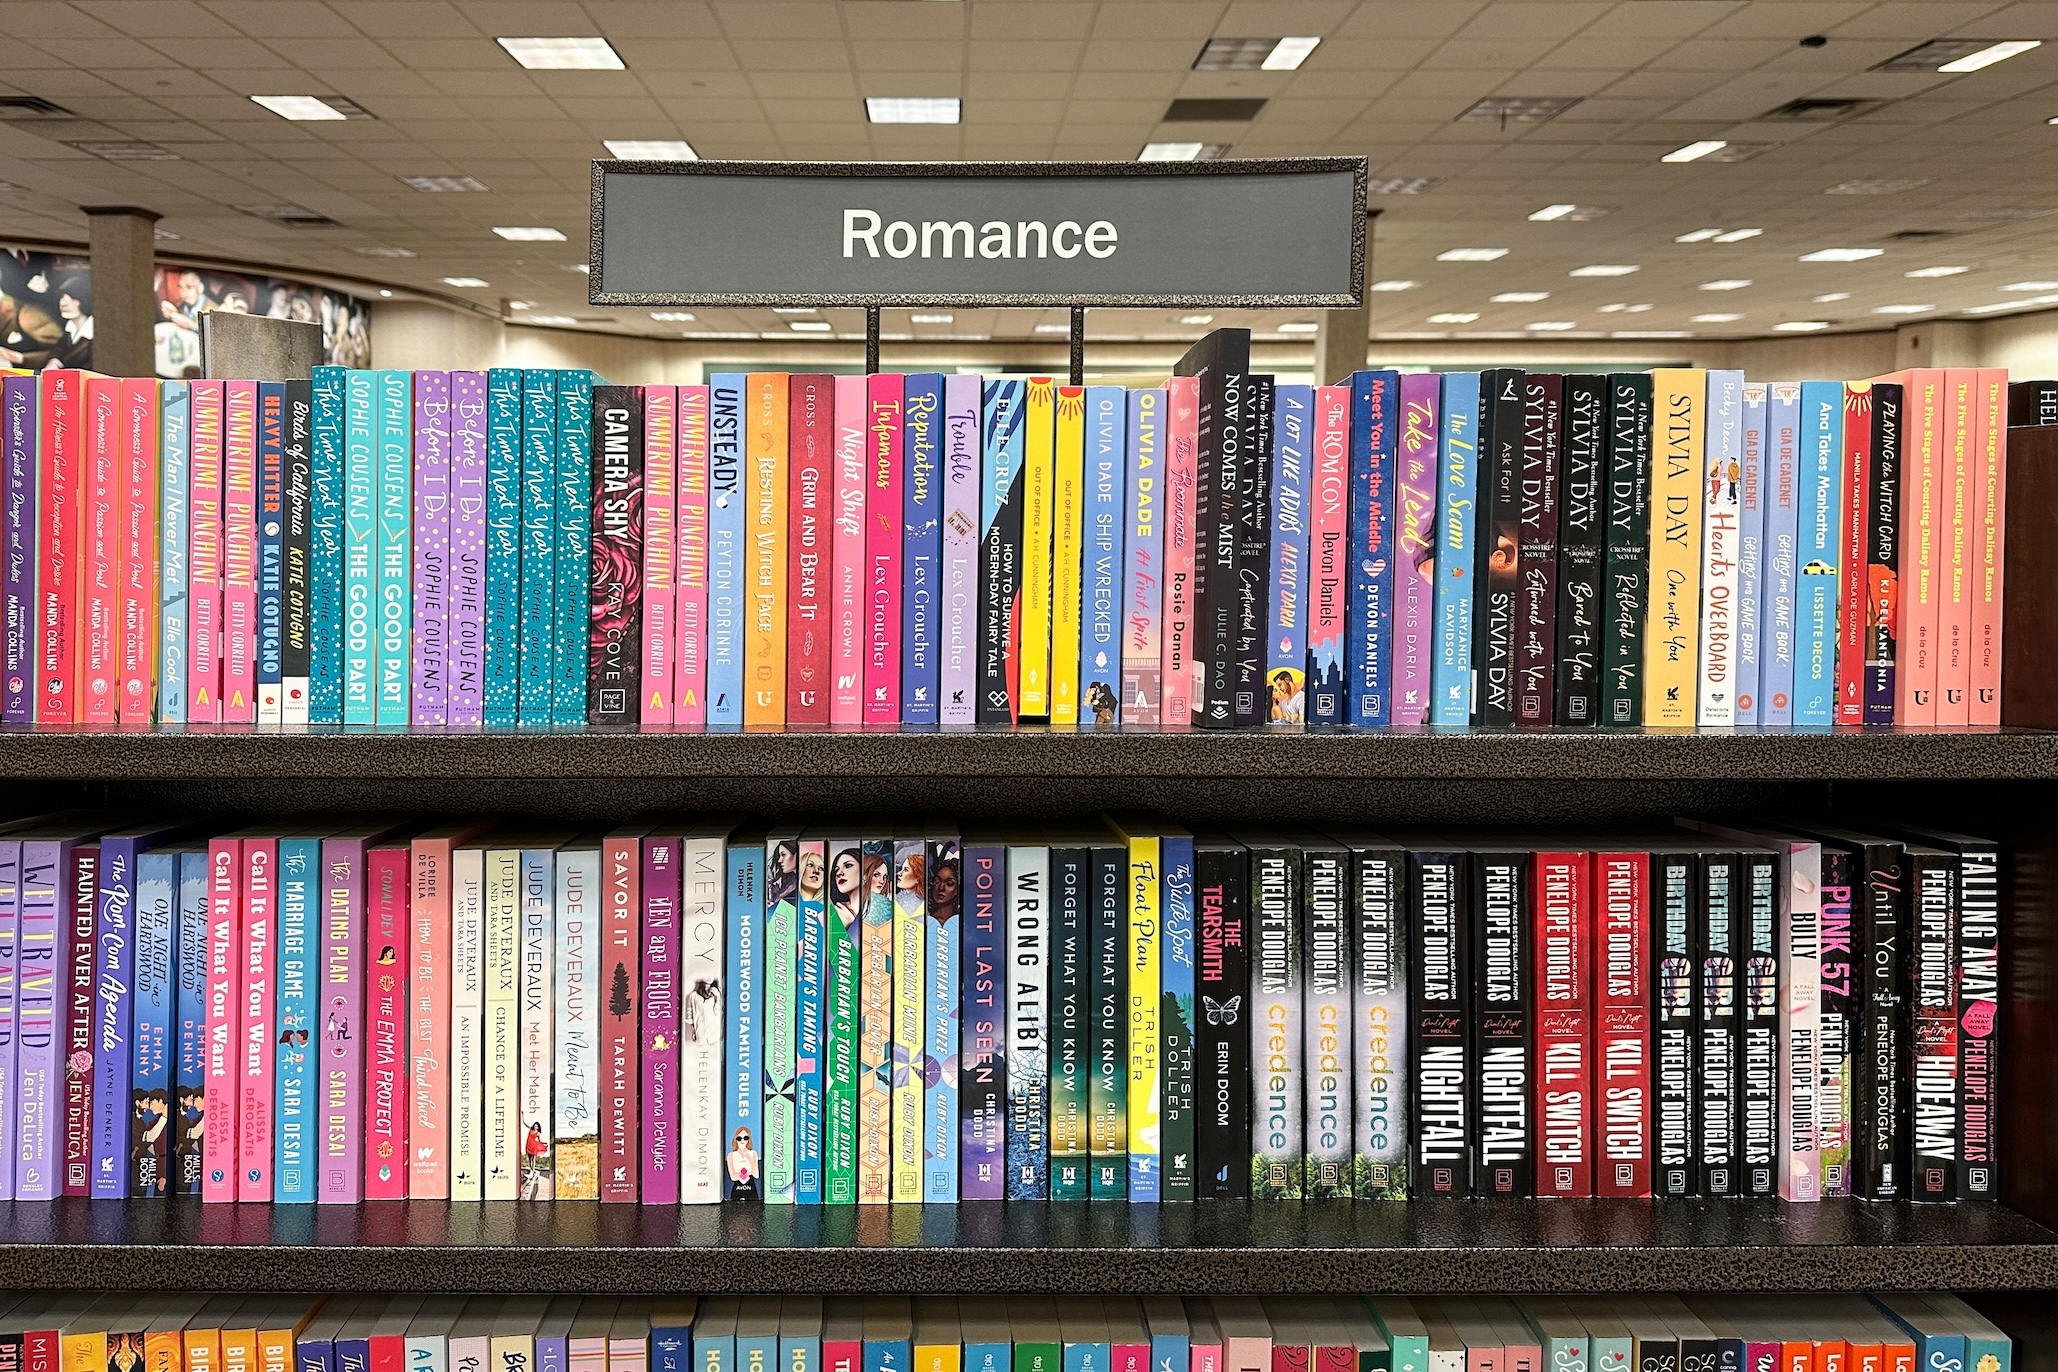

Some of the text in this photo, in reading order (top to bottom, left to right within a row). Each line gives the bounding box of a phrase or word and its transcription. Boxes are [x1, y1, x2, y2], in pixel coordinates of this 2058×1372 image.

[842, 209, 1118, 259] Romance
[167, 414, 184, 443] The
[167, 445, 184, 485] Man
[264, 397, 281, 513] HEAVY HITTER
[350, 375, 372, 520] SOPHIE COUSENS
[422, 396, 448, 520] Before I Do
[604, 409, 629, 539] CAMERA SHY
[714, 388, 738, 495] UNSTEADY
[836, 426, 864, 538] Night Shift
[873, 400, 900, 489] Infamous
[909, 392, 938, 505] Reputation
[949, 409, 977, 484] Trouble
[994, 398, 1010, 505] ELLE CRUZ
[1098, 400, 1113, 503] OLIVIA DADE
[1218, 374, 1240, 570] NOW COMES the MIST
[1665, 394, 1691, 549] SYLVIA DAY
[1815, 401, 1833, 549] Ana Takes Manhattan
[165, 497, 183, 551] Never
[192, 386, 220, 587] SUMMERTIME PUNCHLINE
[165, 552, 182, 583] Met
[716, 530, 732, 666] PEYTON CORINNE
[798, 468, 820, 621] GRIM AND BEAR IT
[7, 594, 19, 671] MANDA COLLINS
[164, 616, 181, 684] Elle Cook
[196, 598, 211, 673] BETTY CORRELLO
[262, 545, 280, 674] KATIE COTUGNO
[289, 547, 305, 650] KATIE COTUGNO
[349, 543, 369, 702] THE GOOD PART
[422, 552, 442, 691] SOPHIE COUSENS
[606, 583, 622, 681] KAY COVE
[843, 567, 853, 657] ANNIE CROWN
[874, 555, 891, 668] Lex Croucher
[988, 526, 1000, 678] MODERN-DAY FAIRY TALE
[1001, 543, 1013, 660] HOW TO SURVIVE A
[1172, 572, 1186, 671] Rosie Danan
[1214, 608, 1227, 690] JULIE C. DAO
[1366, 585, 1379, 688] DEVON DANIELS
[1405, 576, 1419, 680] ALEXIS DARIA
[1811, 586, 1825, 680] LISSETTE DECOS
[1876, 579, 1889, 692] KJ DELL'ANTONIA
[284, 881, 305, 999] MARRIAGE GAME
[465, 880, 477, 992] JUDE DEVERAUX
[614, 851, 629, 947] SAVOR IT
[694, 852, 716, 964] MERCY
[1203, 885, 1223, 981] TEARSMITH
[1224, 919, 1241, 947] THE
[1312, 859, 1337, 995] PENELOPE DOUGLAS
[1790, 911, 1816, 960] BULLY
[1820, 886, 1851, 997] PUNK 57
[1961, 853, 1997, 1003] FALLING AWAY
[72, 858, 94, 1050] HAUNTED EVER AFTER
[248, 851, 268, 1077] Call It What You Want
[975, 858, 993, 1084] POINT LAST SEEN
[1017, 872, 1039, 1051] WRONG ALIBI
[613, 1036, 626, 1092] TARAH
[737, 915, 751, 1118] MOOREWOOD FAMILY RULES
[836, 938, 851, 1084] BARBARIAN'S TOUCH
[69, 1080, 82, 1102] JEN
[375, 995, 394, 1136] THE EMMA PROJECT
[1167, 1035, 1179, 1121] DOLLER
[1181, 1045, 1191, 1110] TRISH
[1217, 1042, 1229, 1126] ERIN DOOM
[1320, 1004, 1343, 1149] credence
[1420, 1046, 1465, 1165] NIGHTFALL
[1545, 1043, 1582, 1163] KILL SWITCH
[1915, 1055, 1956, 1161] HIDEAWAY
[245, 1087, 255, 1157] DEROGATIS
[256, 1101, 265, 1143] ALISSA
[283, 1079, 301, 1165] SARA DESAI
[838, 1098, 851, 1169] RUBY DIXON
[973, 1108, 983, 1138] DODD
[985, 1093, 996, 1153] CHRISTINA
